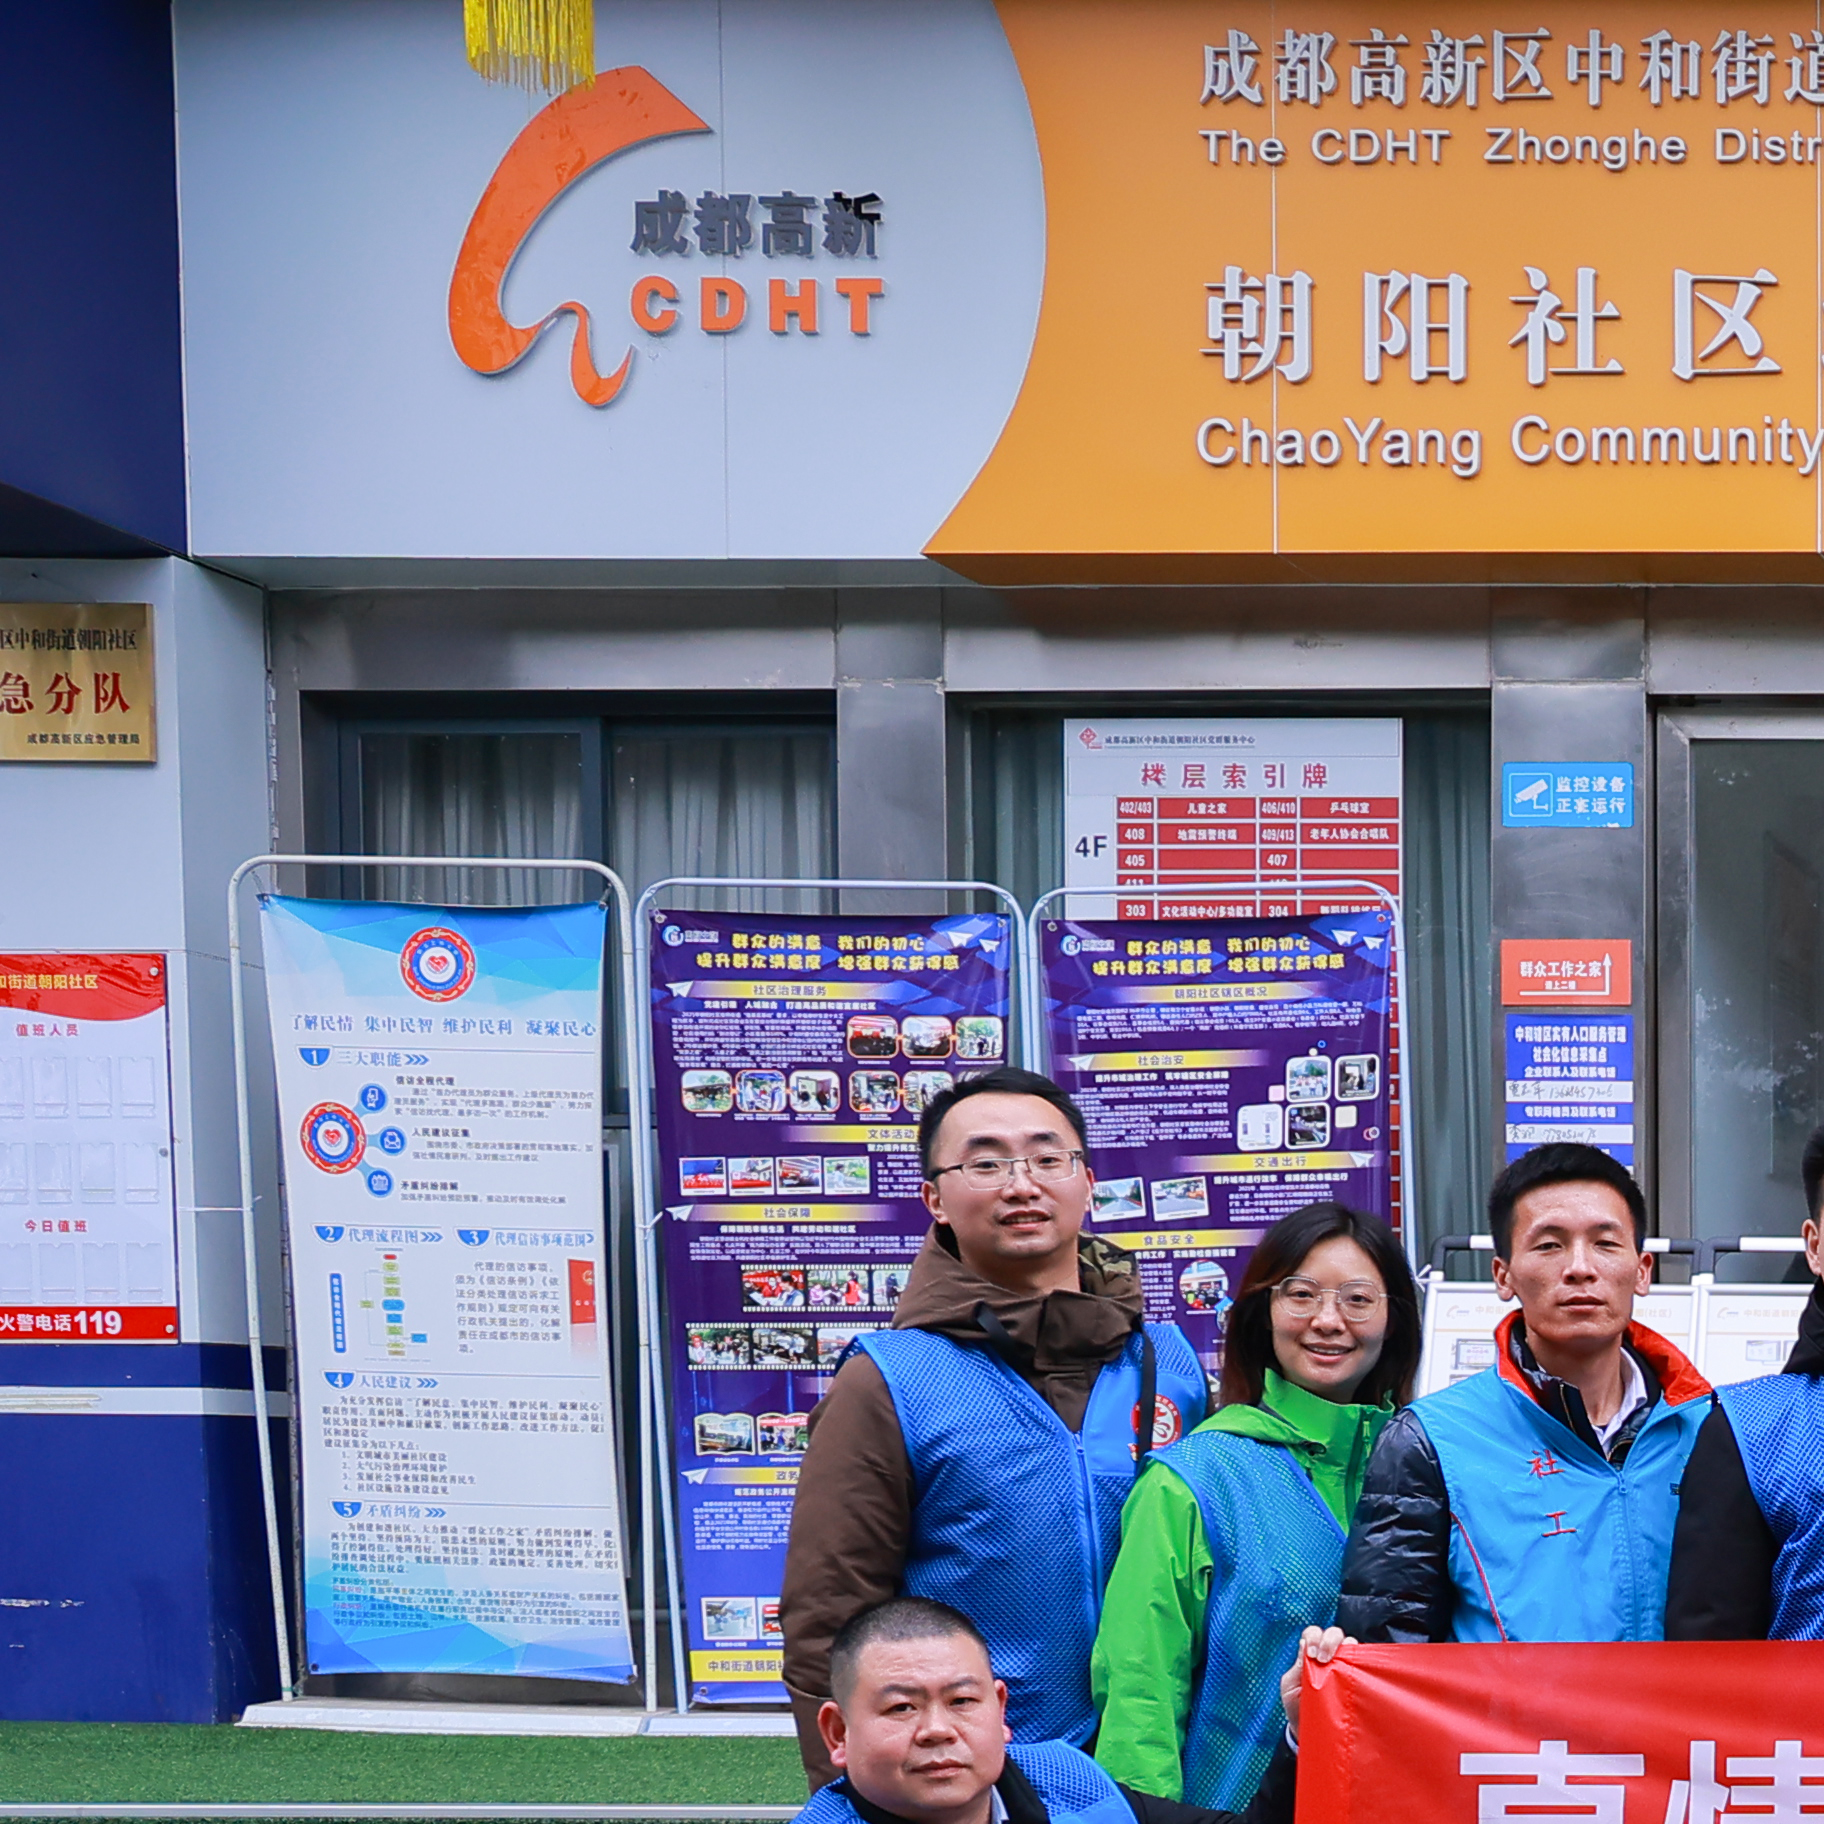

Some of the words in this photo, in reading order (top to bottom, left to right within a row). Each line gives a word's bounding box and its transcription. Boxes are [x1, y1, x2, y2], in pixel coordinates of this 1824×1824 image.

[1199, 128, 1286, 165] The
[1310, 128, 1451, 165] CDHT
[1483, 127, 1687, 171] Zhonghe
[630, 189, 883, 259] 成都高新
[630, 275, 885, 336] CDHT
[1197, 416, 1483, 479] ChaoYang
[0, 672, 130, 715] 急分队
[1141, 763, 1329, 789] 楼层索引牌
[1556, 776, 1626, 793] 监控设备
[1556, 798, 1626, 814] 正在运行
[1074, 835, 1108, 858] 4F
[1125, 855, 1146, 867] 405
[1267, 854, 1288, 867] 407
[1126, 905, 1146, 917] 303
[1268, 905, 1289, 917] 304
[1519, 961, 1603, 978] 群众工作之家
[16, 1024, 78, 1036] 值班人员
[291, 1014, 353, 1032] 了解民情
[364, 1016, 433, 1035] 集中民智
[25, 1220, 88, 1232] 今日值班
